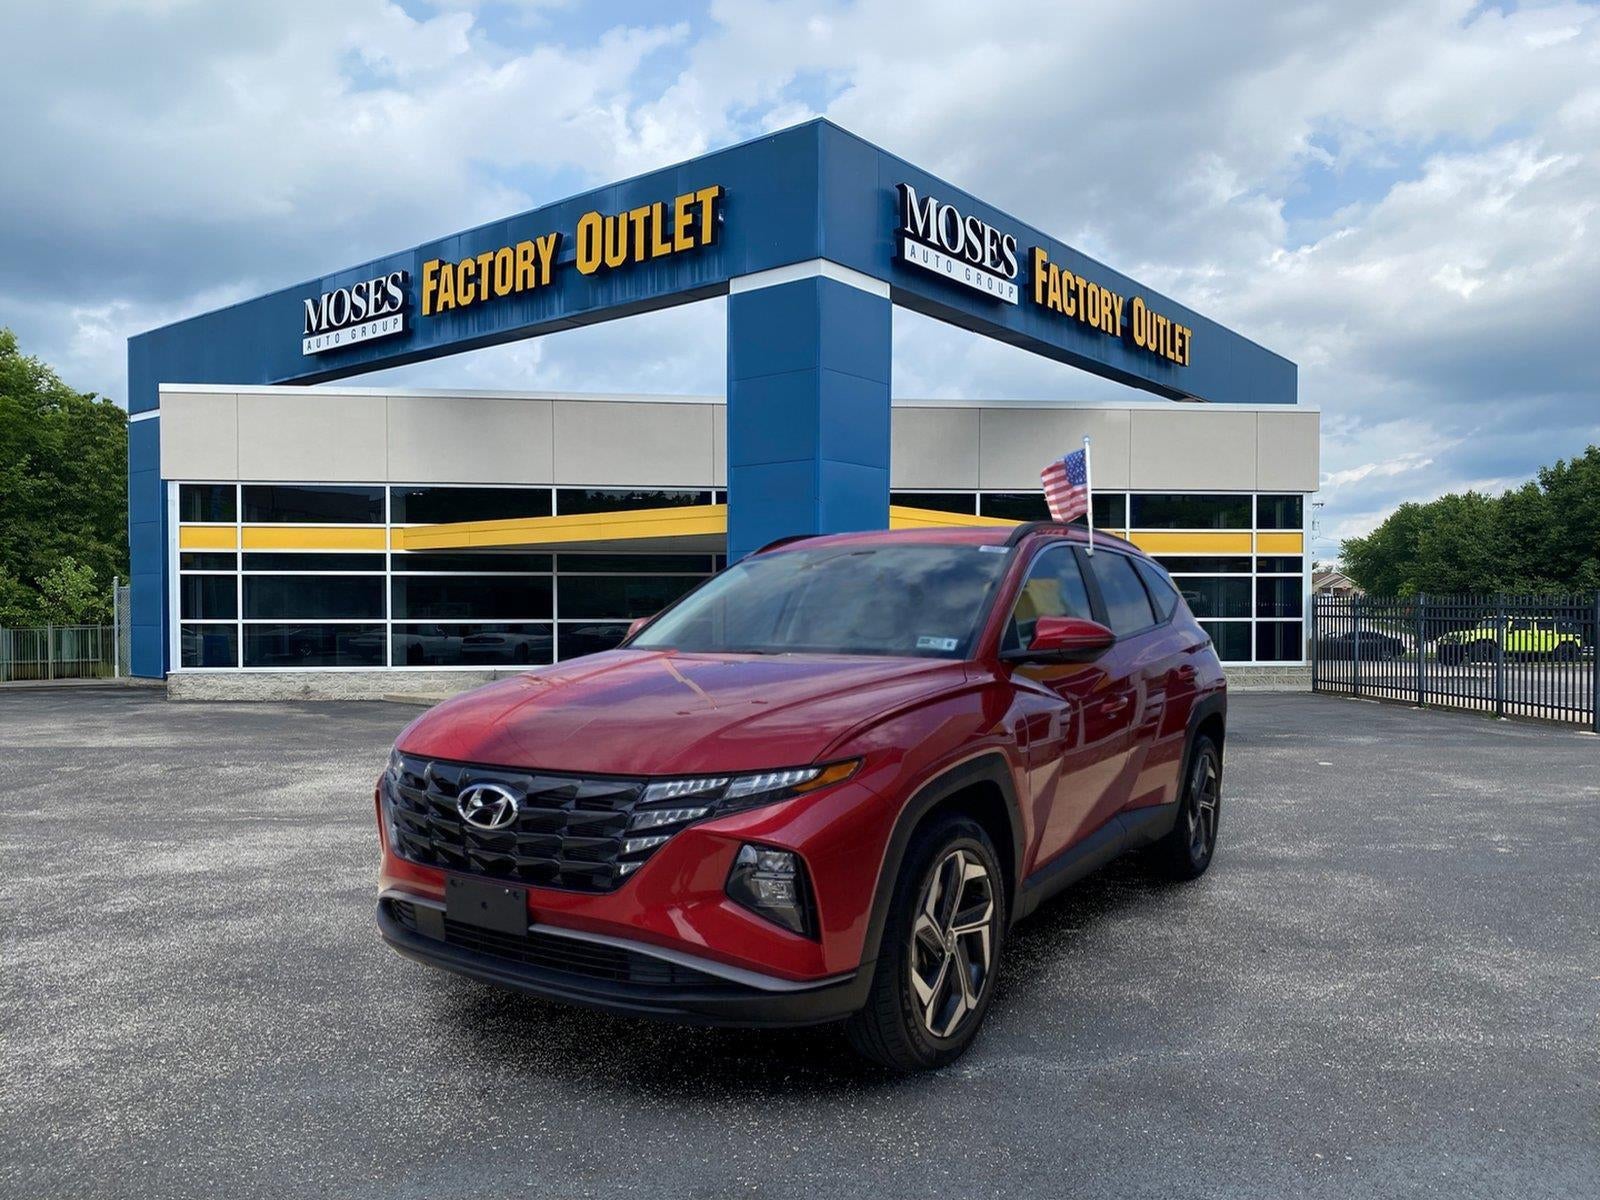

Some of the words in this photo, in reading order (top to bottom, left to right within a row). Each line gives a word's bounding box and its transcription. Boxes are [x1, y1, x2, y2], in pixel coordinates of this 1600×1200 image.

[422, 232, 558, 316] FACTORY
[576, 185, 720, 276] OUTLET
[904, 183, 1018, 279] MOSES
[303, 271, 403, 334] MOSES
[910, 244, 952, 273] AUTO
[965, 268, 1014, 298] GROUP
[1034, 246, 1124, 338] FACTORY
[1132, 296, 1192, 367] OUTLET
[307, 332, 340, 351] AUTO
[351, 318, 399, 340] GROUP
